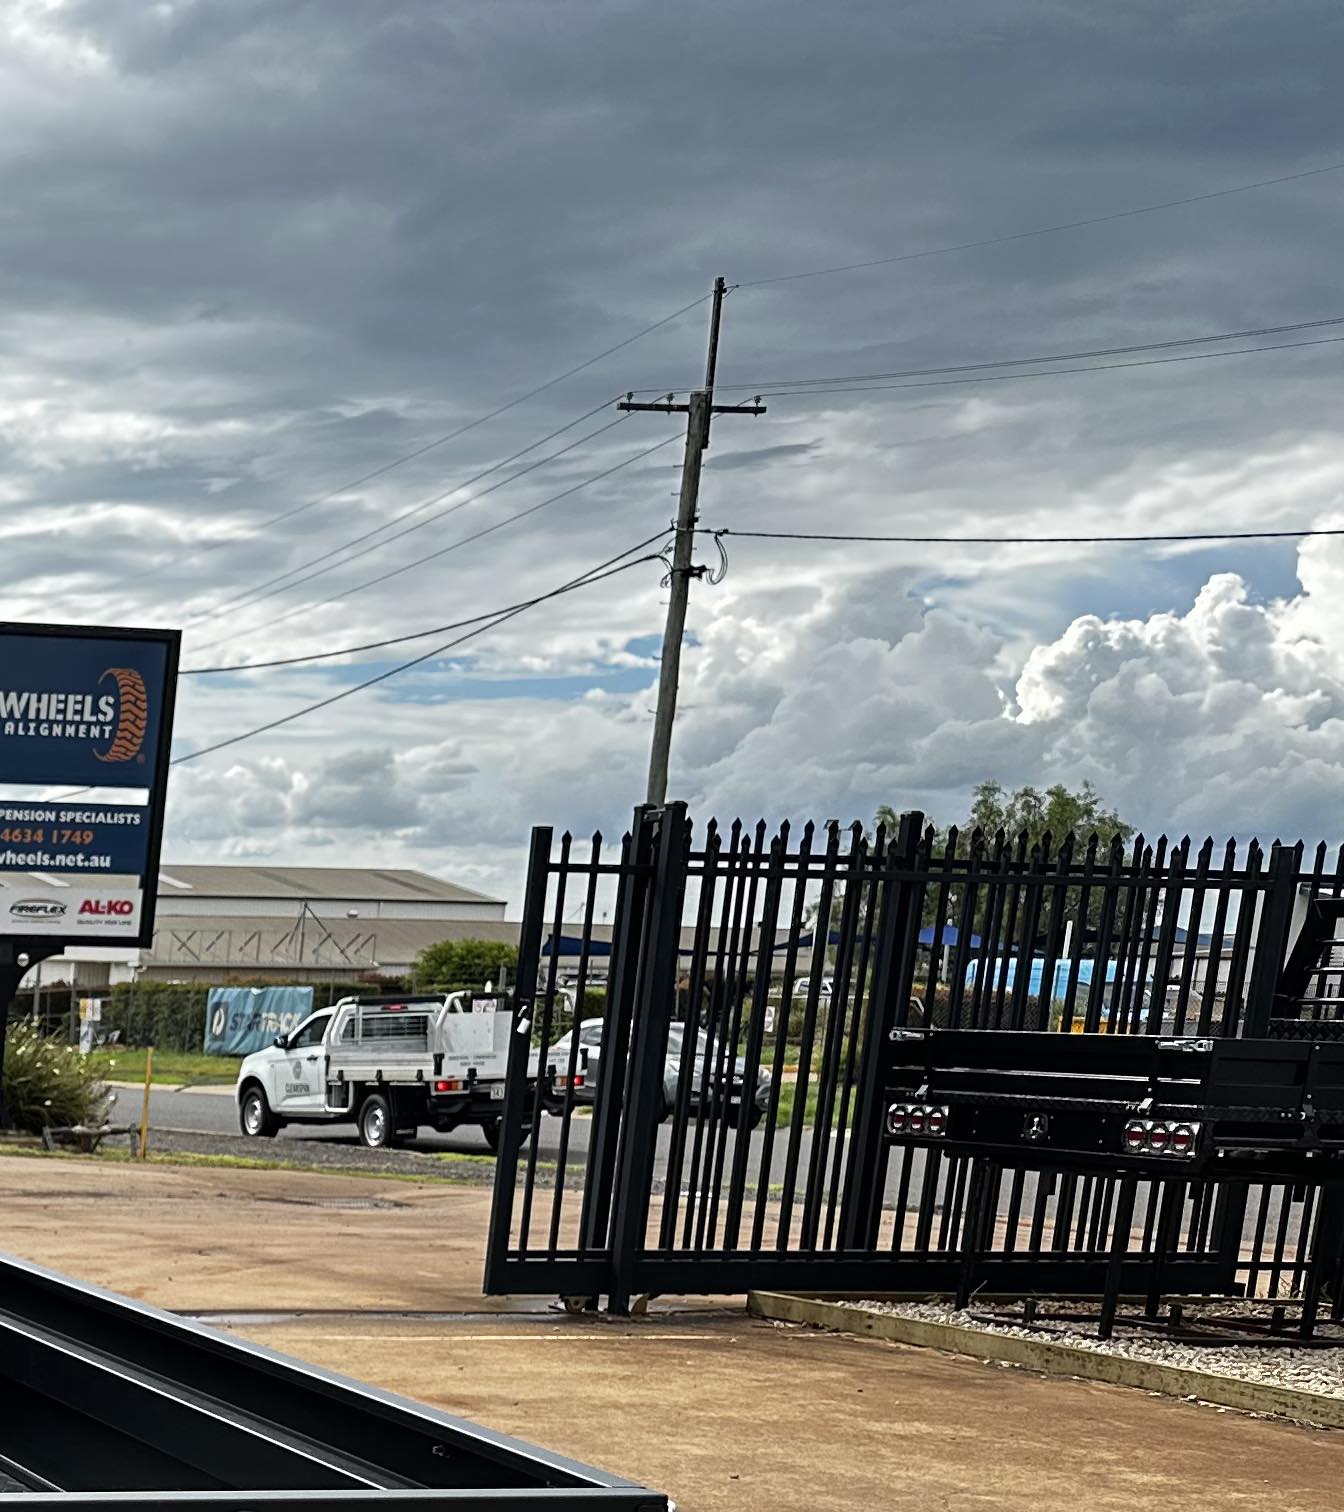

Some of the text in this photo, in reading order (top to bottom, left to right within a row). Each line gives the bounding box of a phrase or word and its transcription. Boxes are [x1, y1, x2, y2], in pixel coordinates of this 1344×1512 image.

[4, 721, 113, 739] ALIGNMENT
[59, 811, 141, 825] SPECIALISTS
[0, 828, 44, 842] 4634
[51, 830, 94, 844] 1749
[9, 904, 68, 915] FIREFLEX
[77, 899, 134, 916] AL-KO
